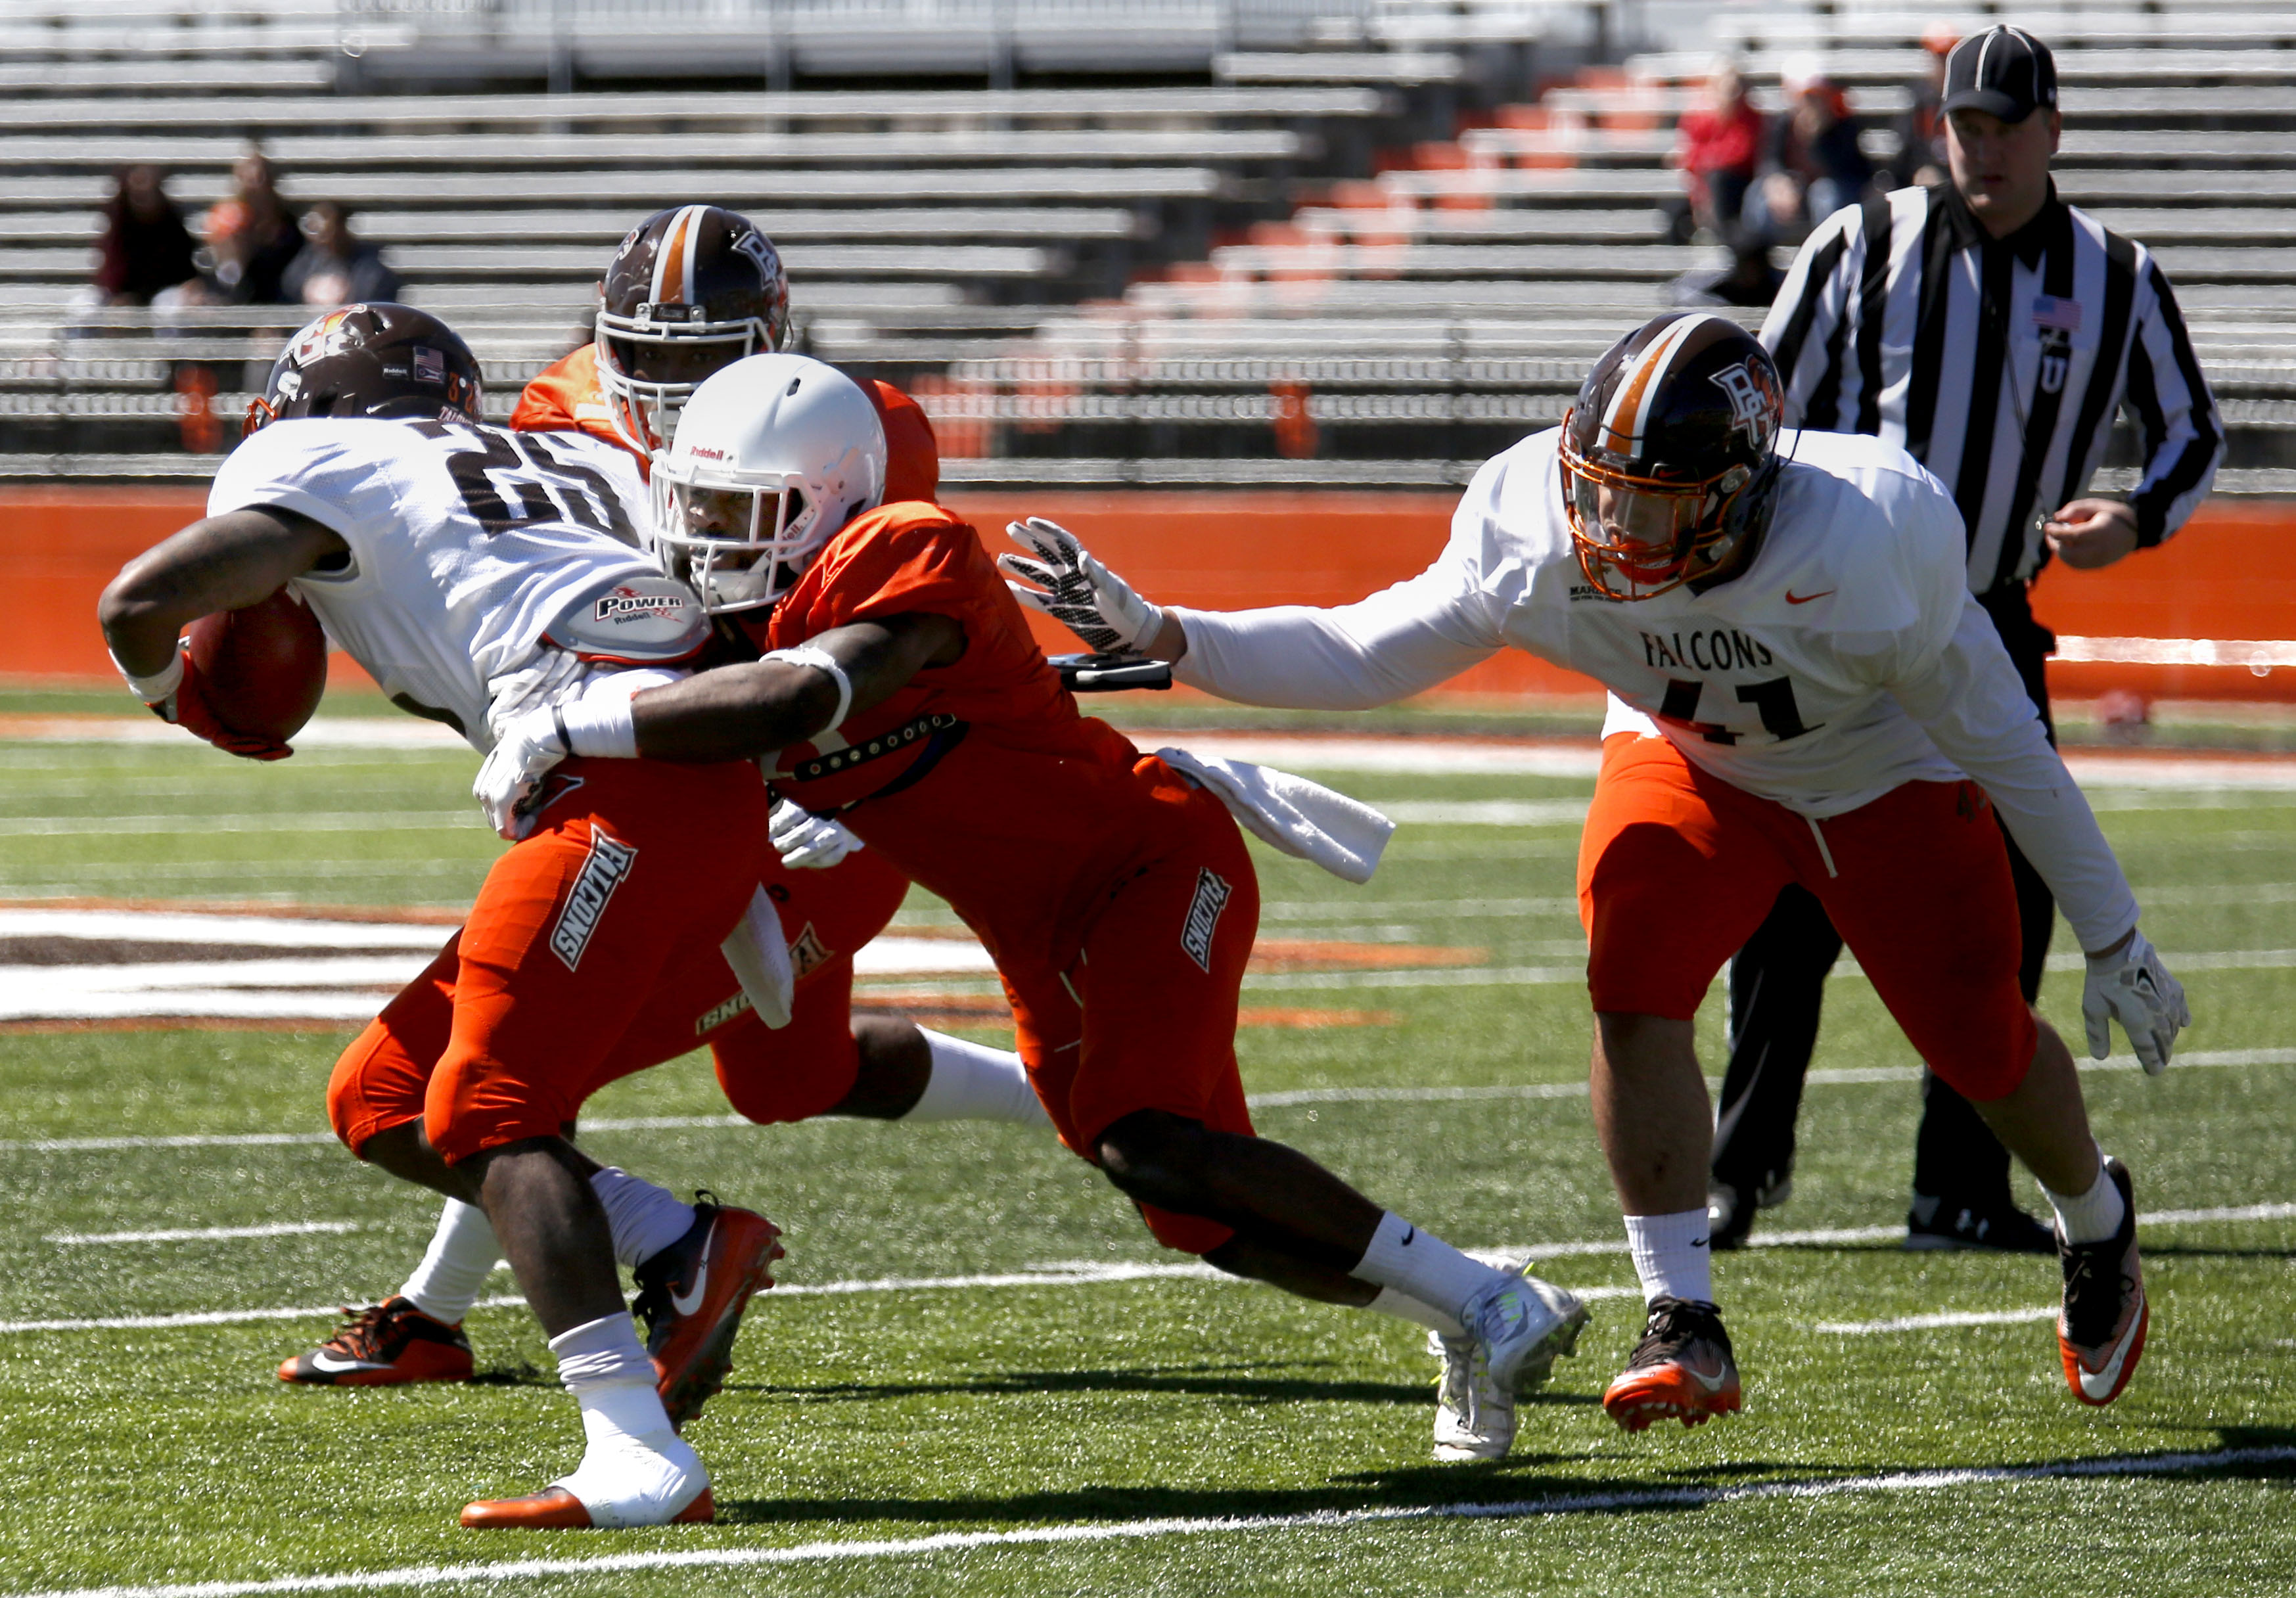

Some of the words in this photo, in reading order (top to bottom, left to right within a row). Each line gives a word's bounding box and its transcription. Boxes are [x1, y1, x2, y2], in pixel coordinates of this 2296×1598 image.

[614, 612, 651, 625] Riddell
[1640, 629, 1773, 671] FALCONS
[1658, 675, 1826, 746] 41
[553, 832, 631, 966] FALCONS
